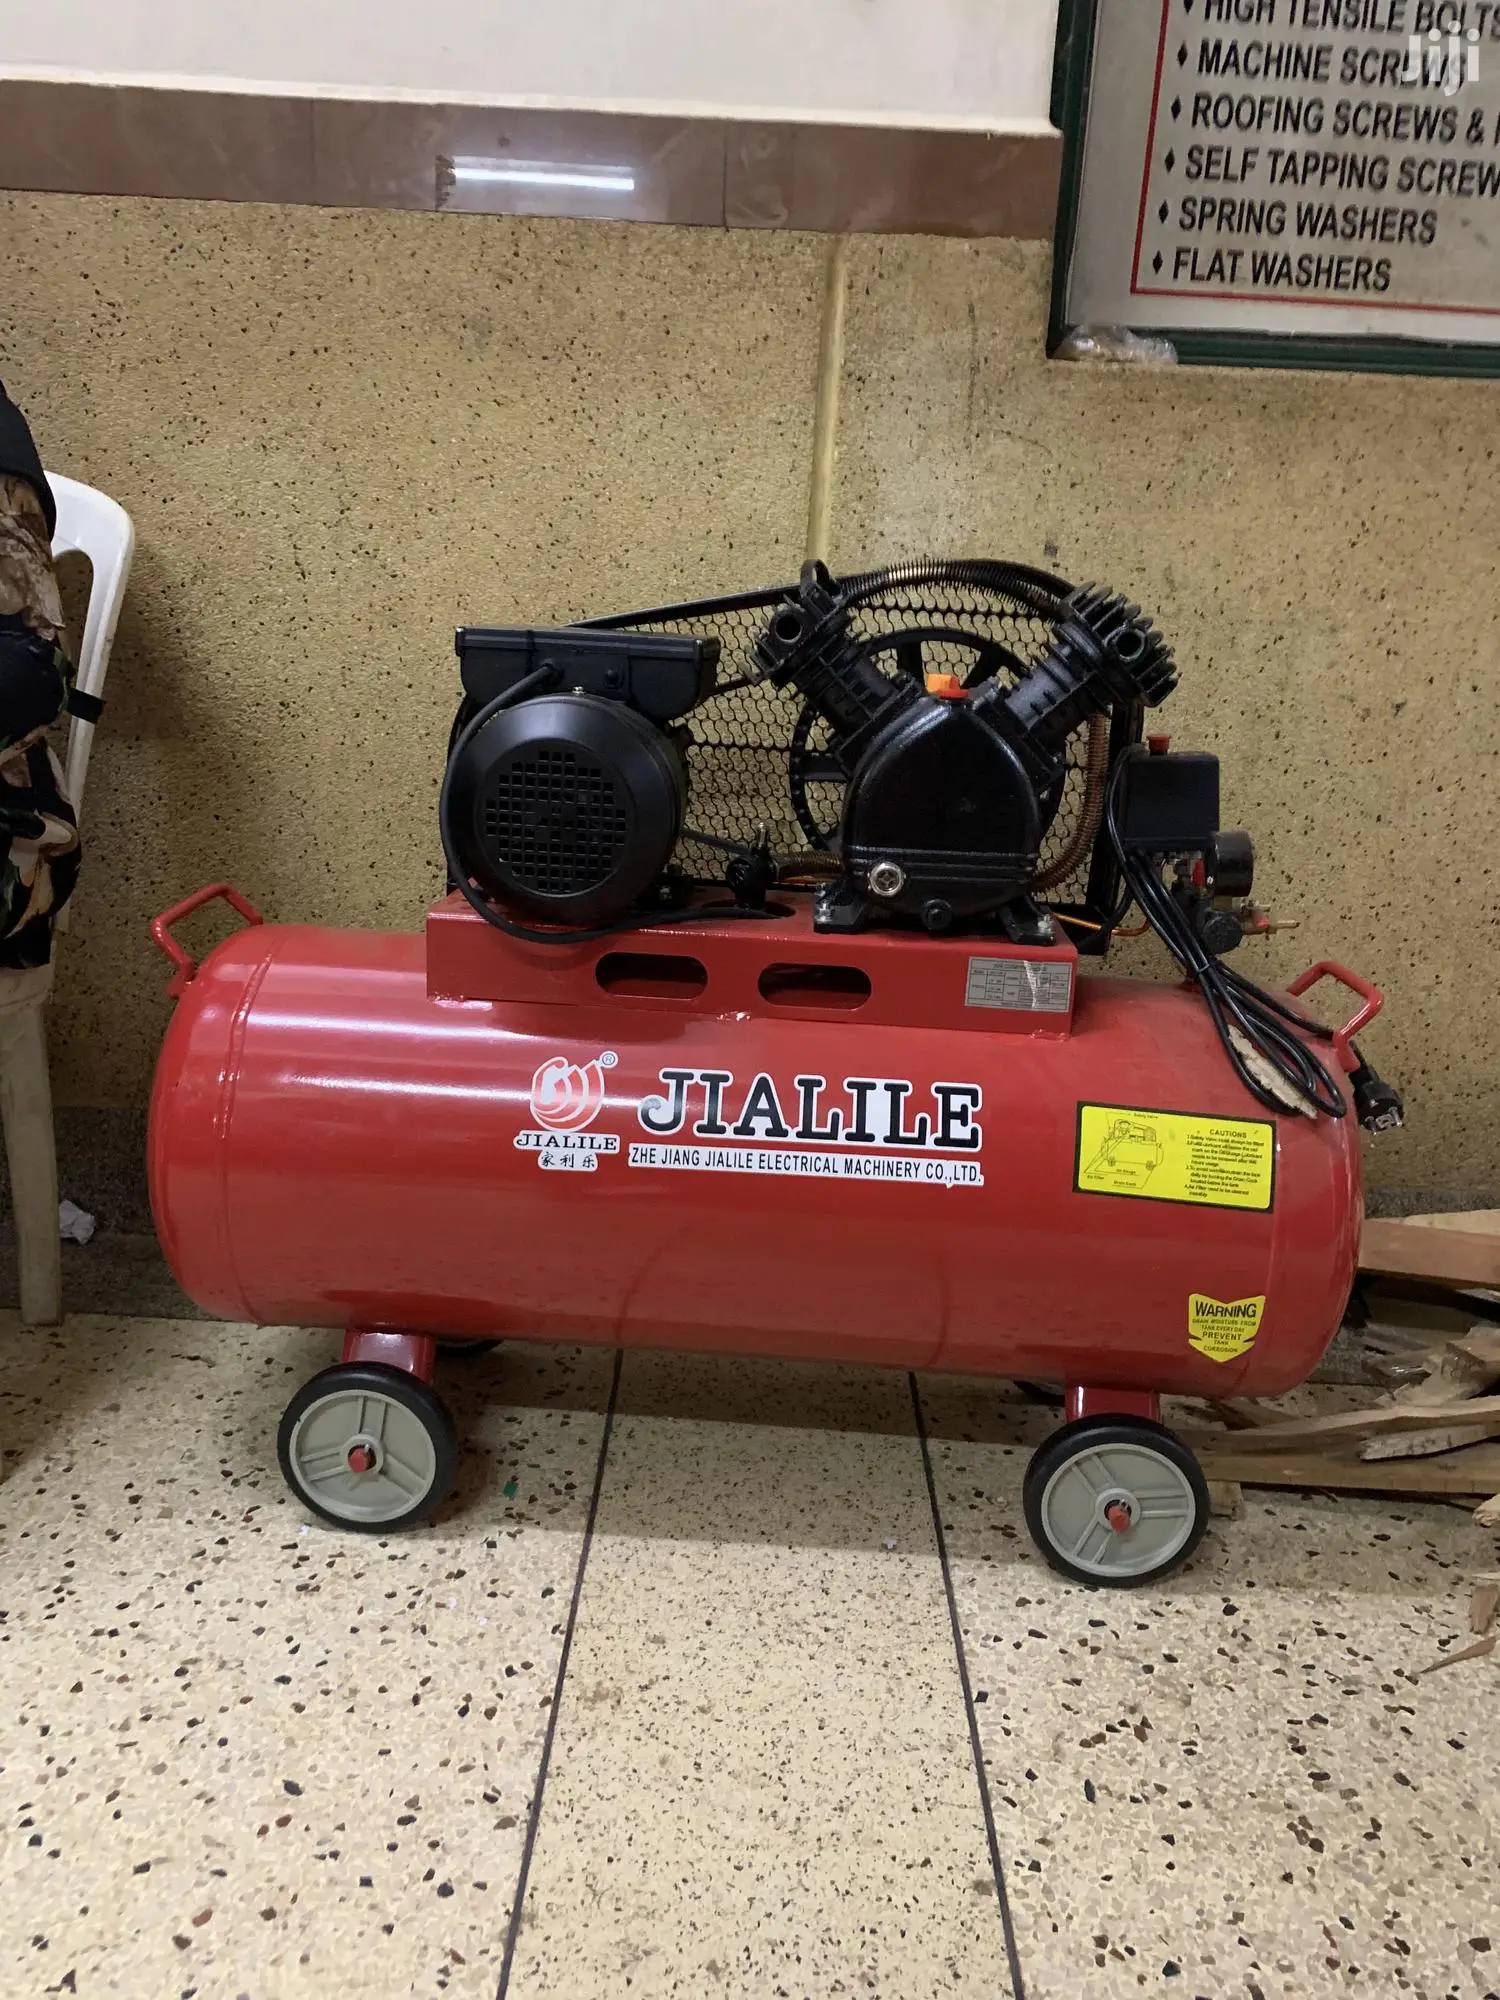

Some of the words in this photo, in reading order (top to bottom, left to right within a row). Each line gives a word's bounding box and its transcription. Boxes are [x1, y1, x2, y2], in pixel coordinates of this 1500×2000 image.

[1204, 0, 1276, 23] HIGH
[1289, 0, 1405, 33] TENSILE
[1198, 39, 1333, 84] MACHINE
[1191, 91, 1325, 135] ROOFING
[1333, 98, 1458, 144] SCREWS
[1466, 107, 1485, 147] &
[1185, 143, 1259, 184] SELF
[1267, 148, 1389, 194] TAPPING
[1179, 195, 1287, 236] SPRING
[1297, 200, 1438, 245] WASHERS
[1172, 246, 1244, 284] FLAT
[1252, 251, 1392, 292] WASHERS
[640, 1071, 979, 1149] JIALILE
[516, 1133, 618, 1151] JIALILE
[1210, 1128, 1247, 1138] CAUTIONS
[631, 1147, 657, 1165] ZHE
[661, 1148, 700, 1167] JIANG
[705, 1151, 753, 1169] JIALILE
[758, 1153, 839, 1174] ELECTRICAL
[844, 1157, 921, 1178] MACHINERY
[1195, 1300, 1257, 1318] WARNING
[1202, 1332, 1242, 1340] PREVENT
